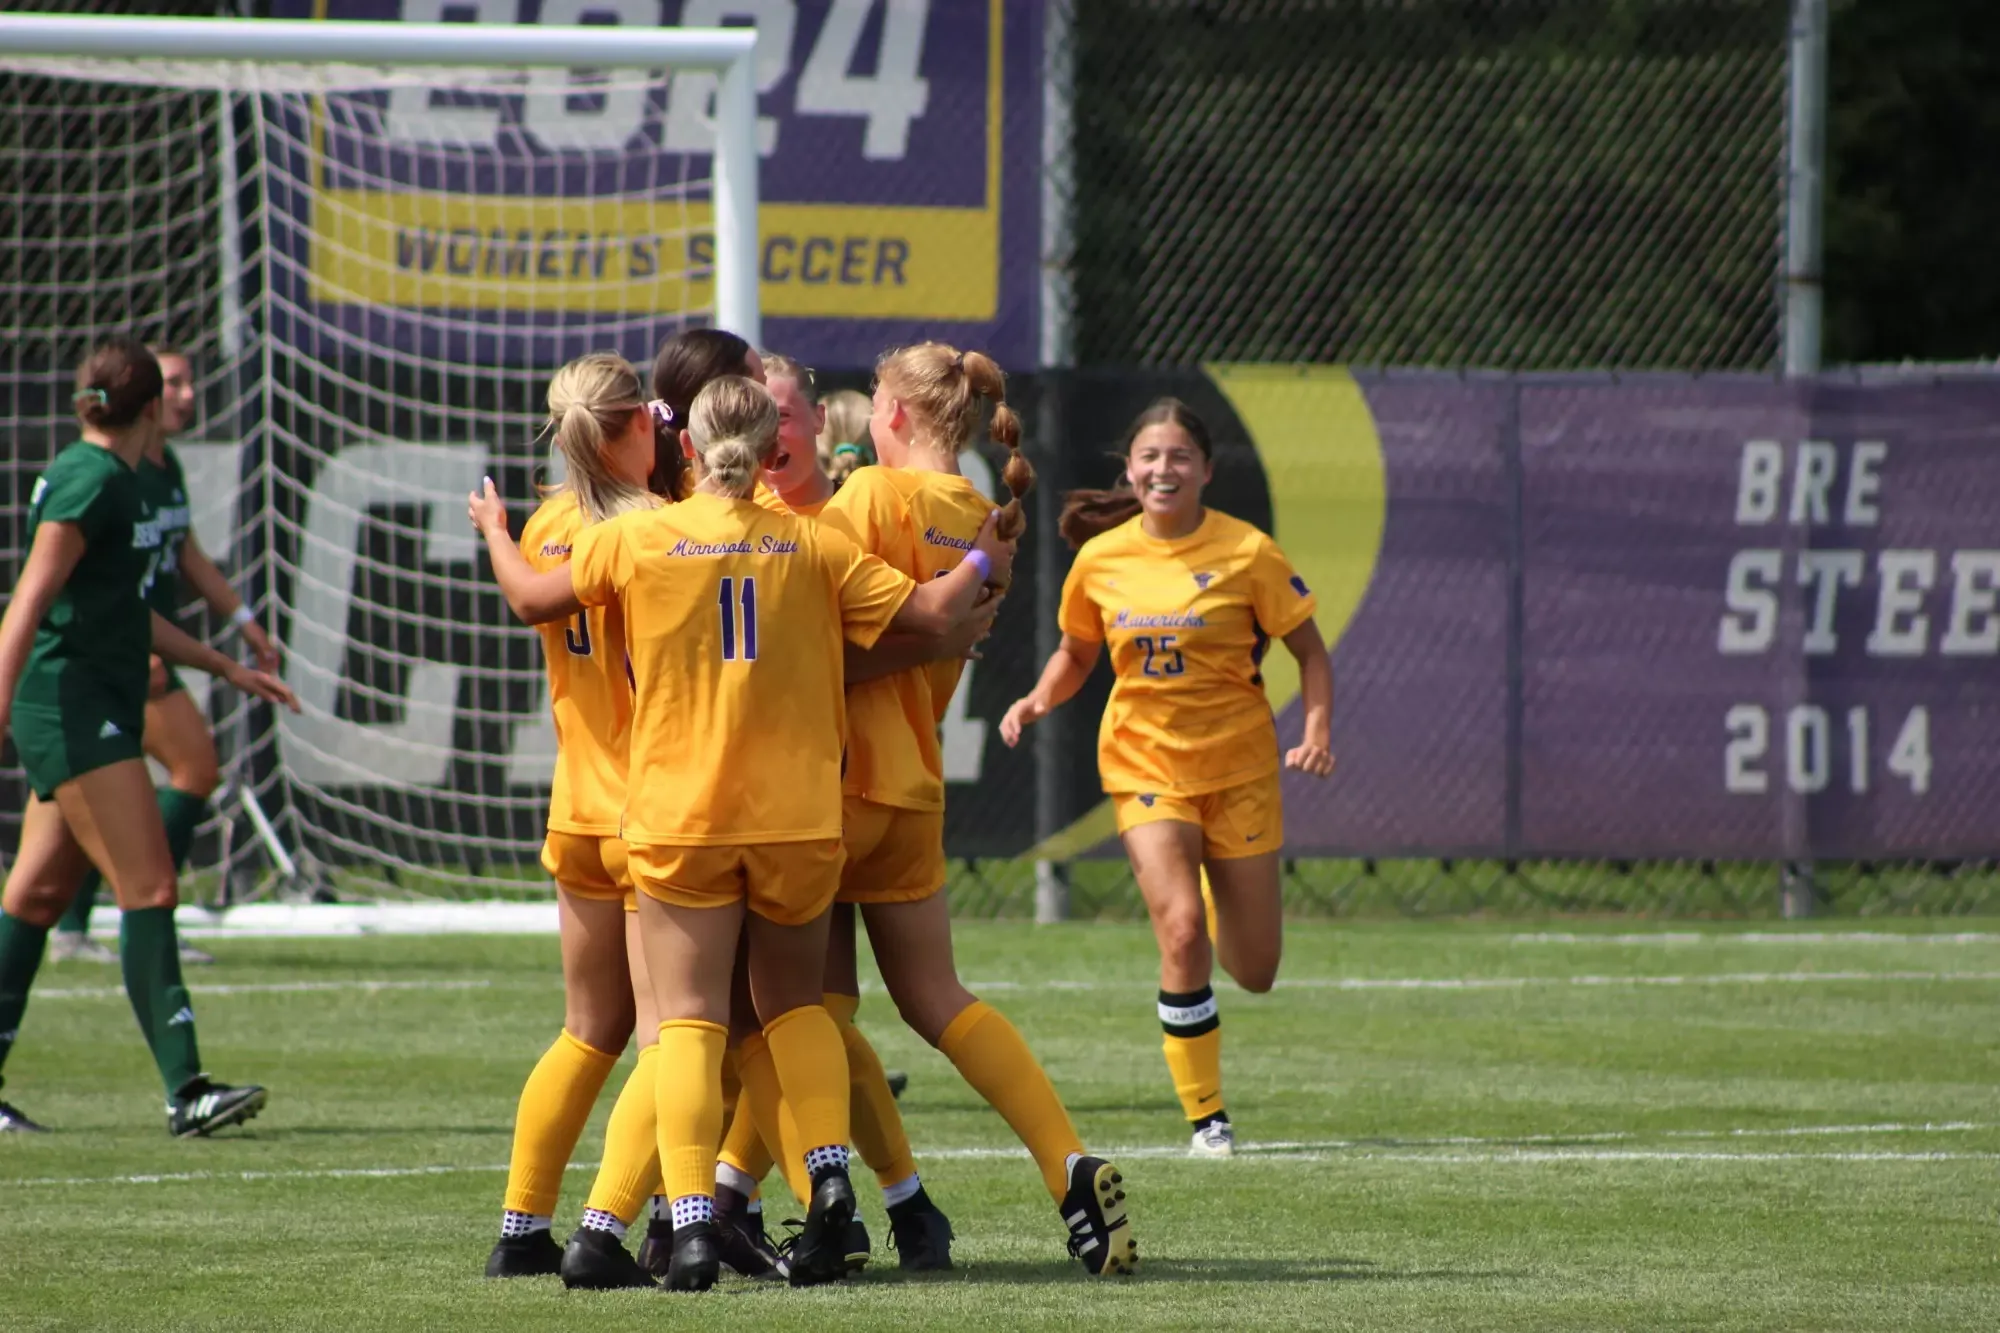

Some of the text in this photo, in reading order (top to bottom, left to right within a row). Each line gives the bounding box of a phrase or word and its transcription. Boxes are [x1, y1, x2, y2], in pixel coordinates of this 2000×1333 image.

[397, 226, 910, 286] WOMEN'S SCCER
[1735, 441, 1888, 525] BRE
[667, 535, 797, 556] Minnesota State
[718, 576, 757, 661] 11
[1718, 548, 2000, 656] STEE
[1134, 635, 1184, 676] 25
[1724, 705, 1932, 794] 2014
